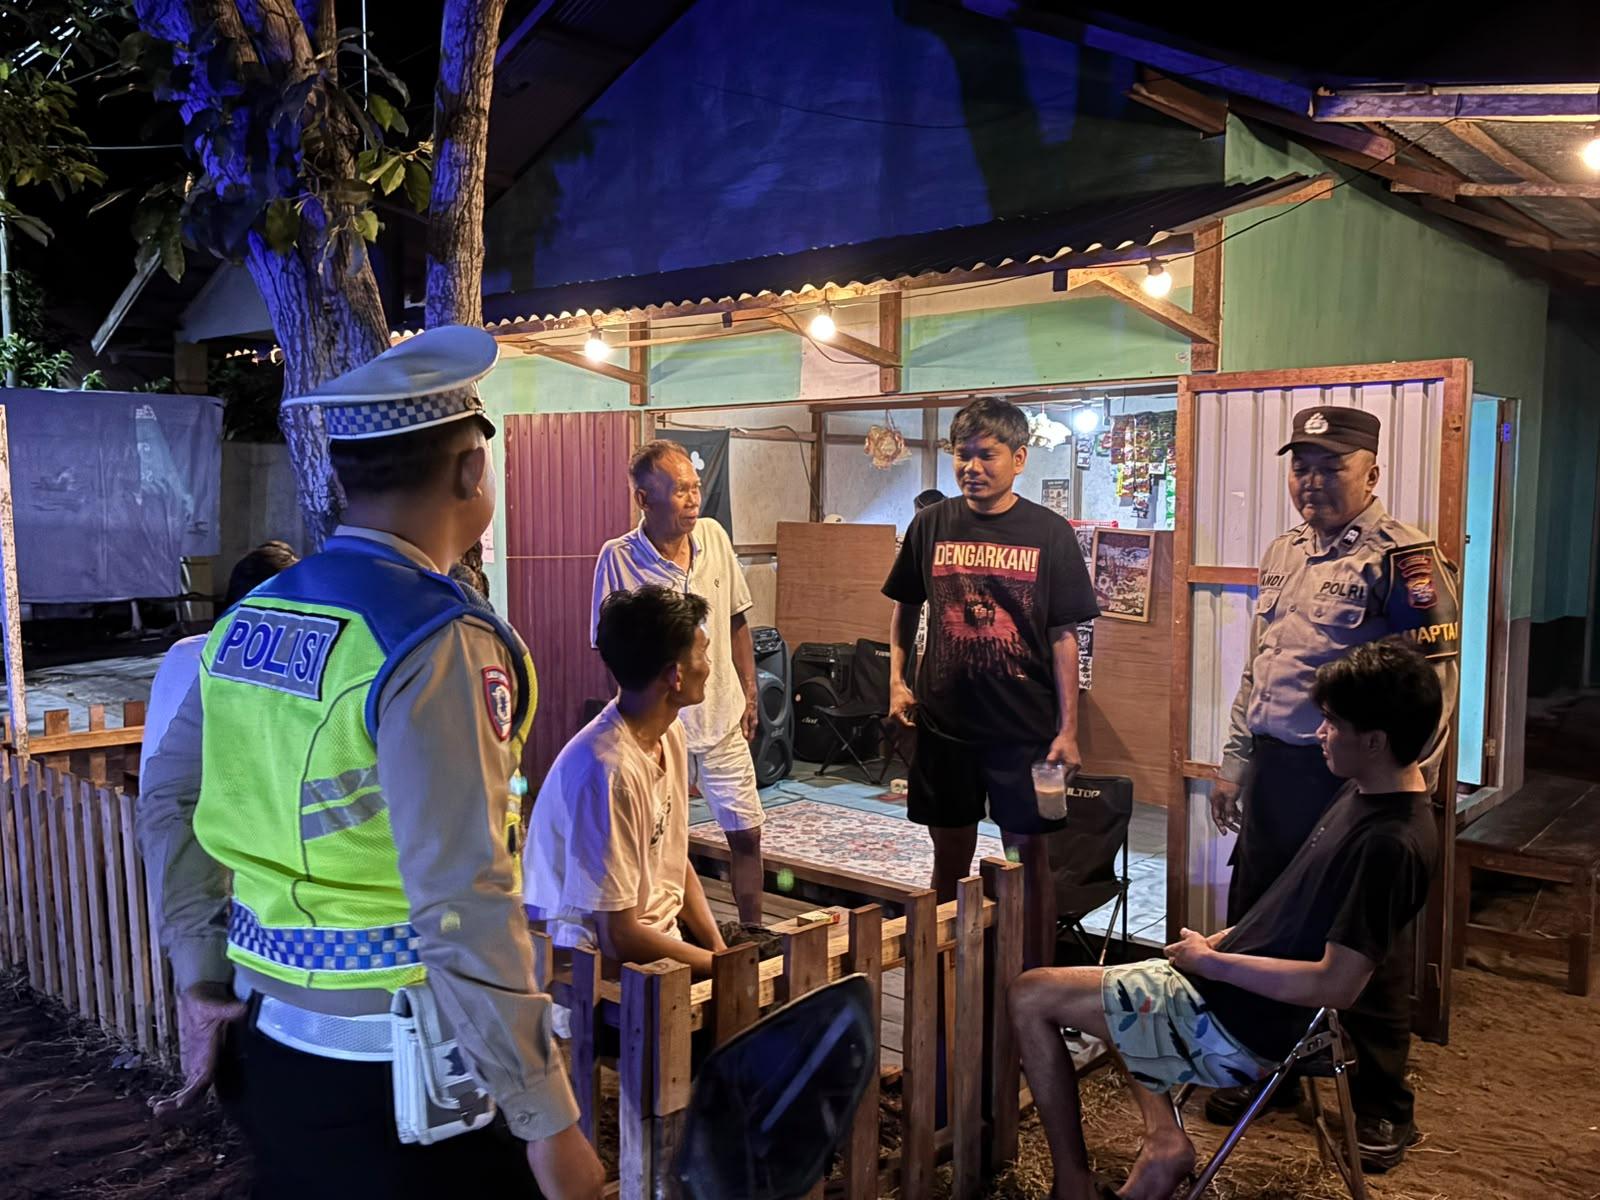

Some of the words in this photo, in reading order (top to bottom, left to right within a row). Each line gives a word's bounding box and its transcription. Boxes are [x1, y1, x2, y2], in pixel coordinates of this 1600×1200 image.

[934, 543, 1038, 572] DENGARKAN!
[1320, 581, 1365, 599] POLRI
[216, 618, 329, 685] POLISI
[1066, 786, 1101, 798] ILTOP
